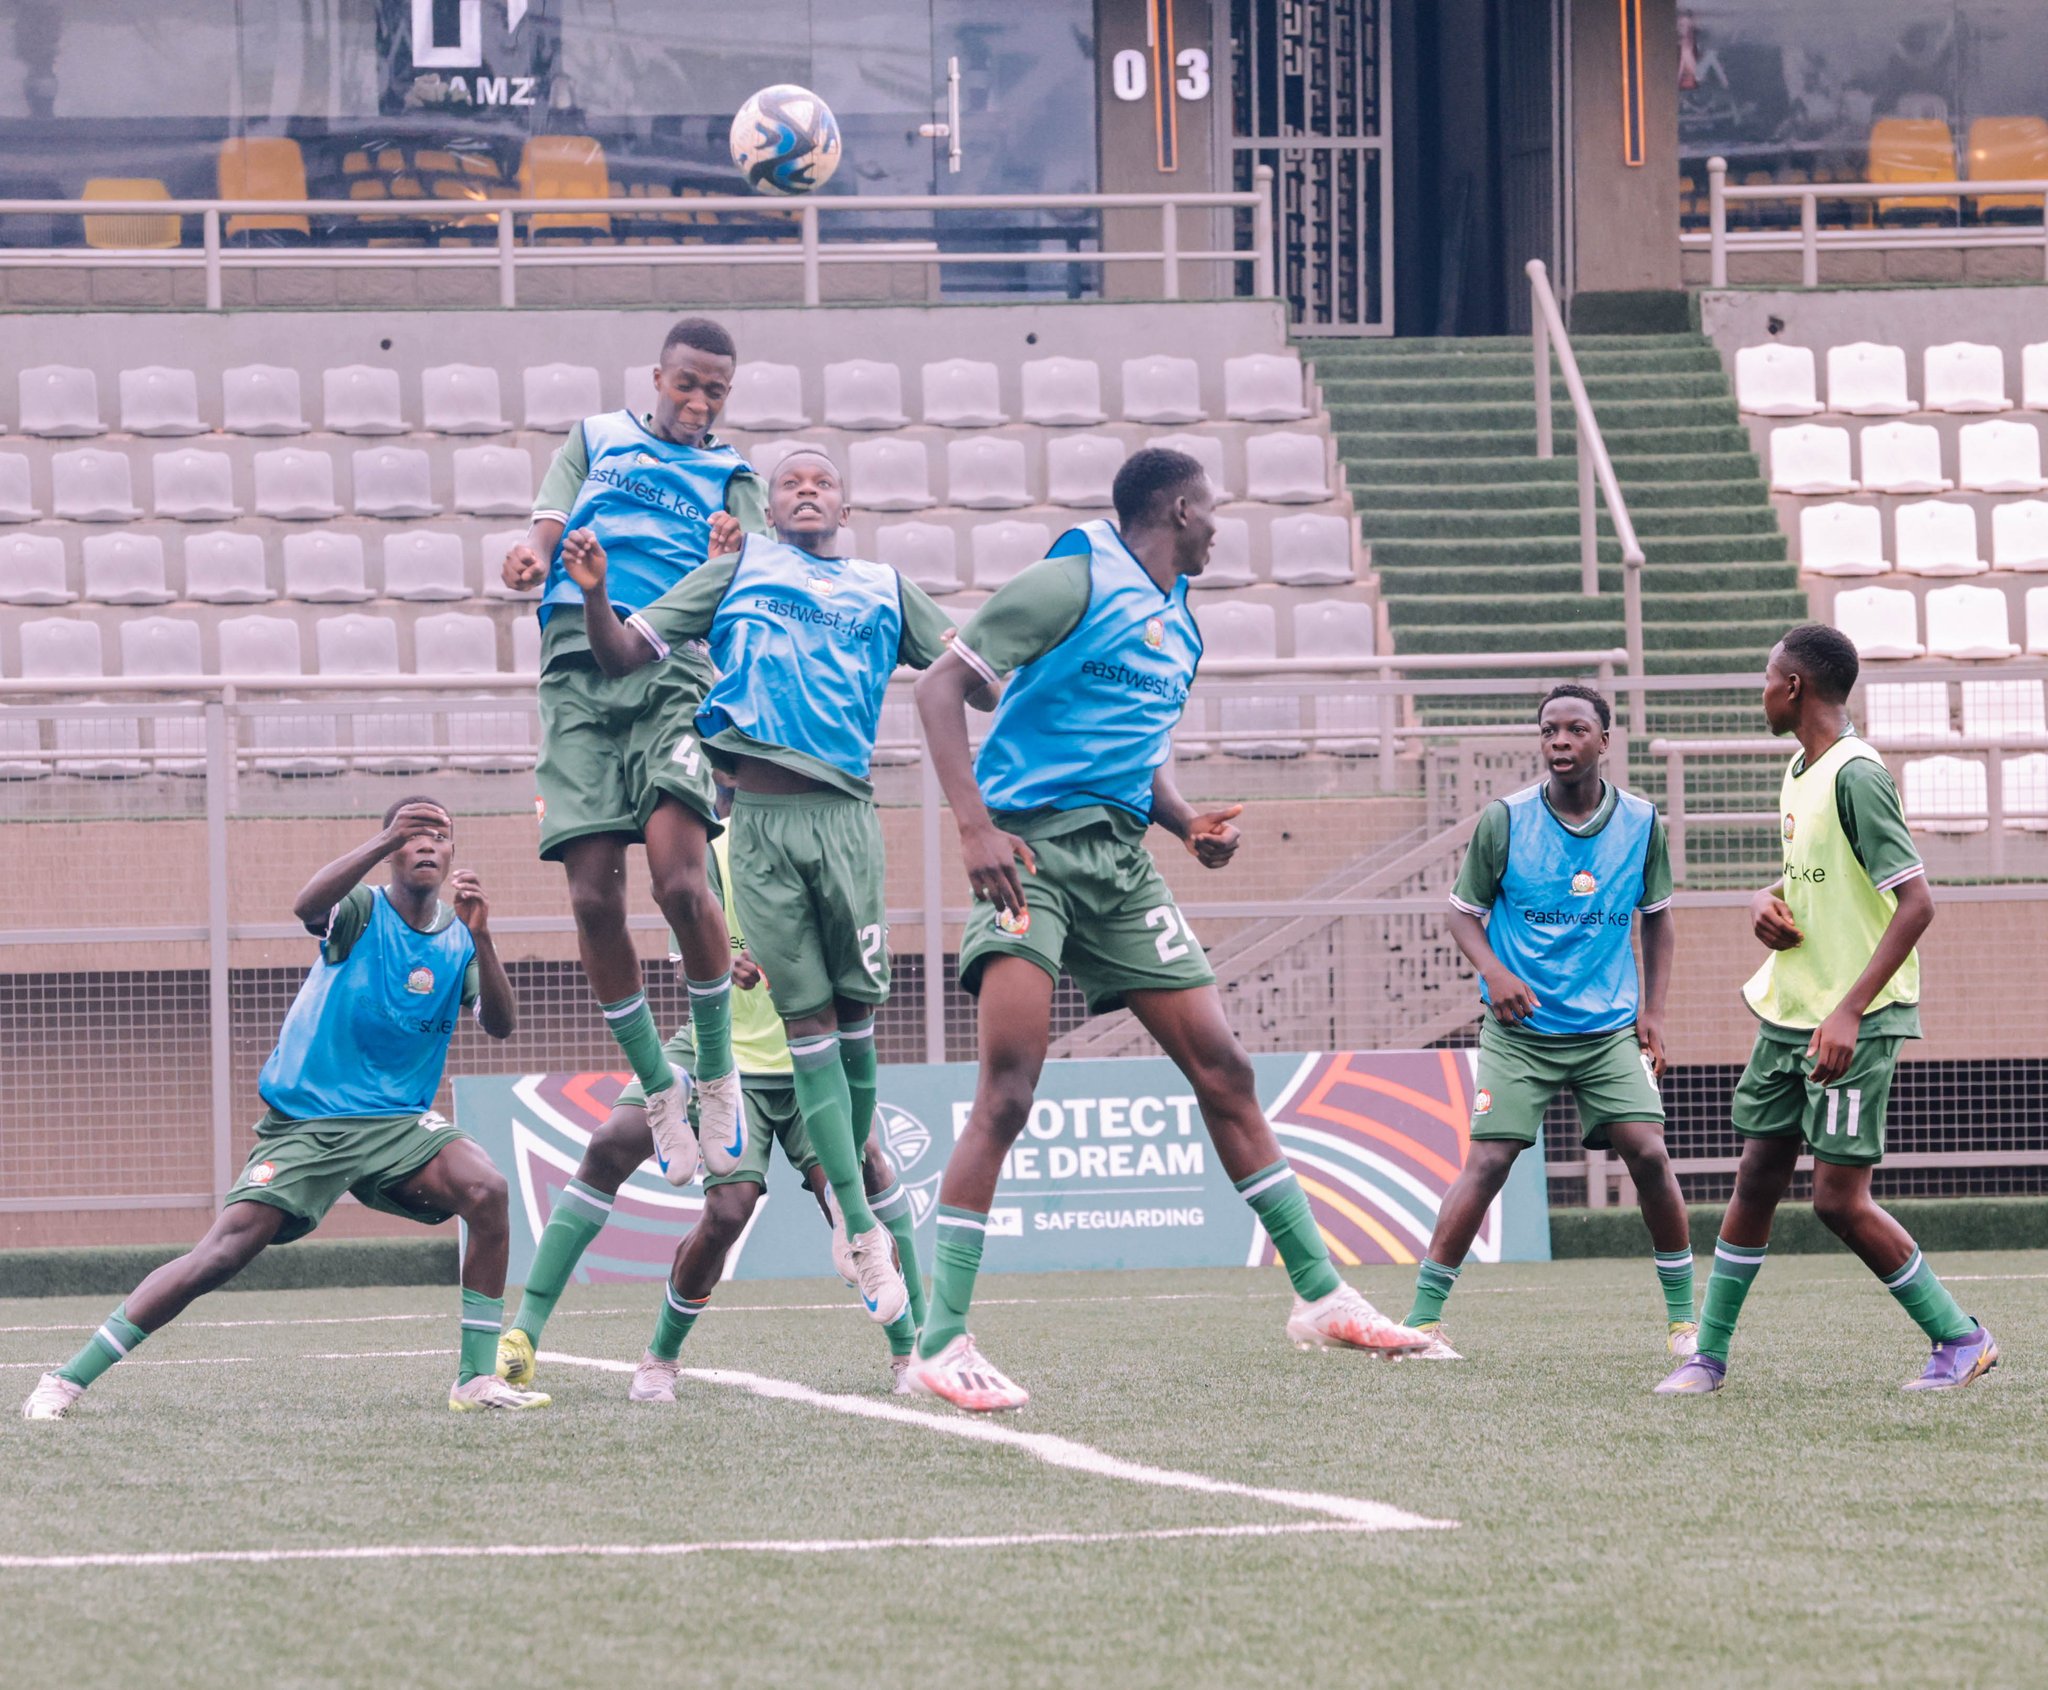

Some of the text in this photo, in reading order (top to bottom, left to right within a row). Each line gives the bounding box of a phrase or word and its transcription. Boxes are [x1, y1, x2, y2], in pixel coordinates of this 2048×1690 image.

[414, 76, 536, 106] AMZ
[588, 468, 700, 520] astwest.ke
[671, 734, 700, 777] 4
[1145, 904, 1200, 963] 2
[1524, 908, 1629, 927] eastwestke
[952, 1095, 1199, 1142] POTECT
[1825, 1088, 1861, 1137] 11
[1047, 1142, 1205, 1179] DREAM
[1033, 1208, 1205, 1231] SAFEGUARDING
